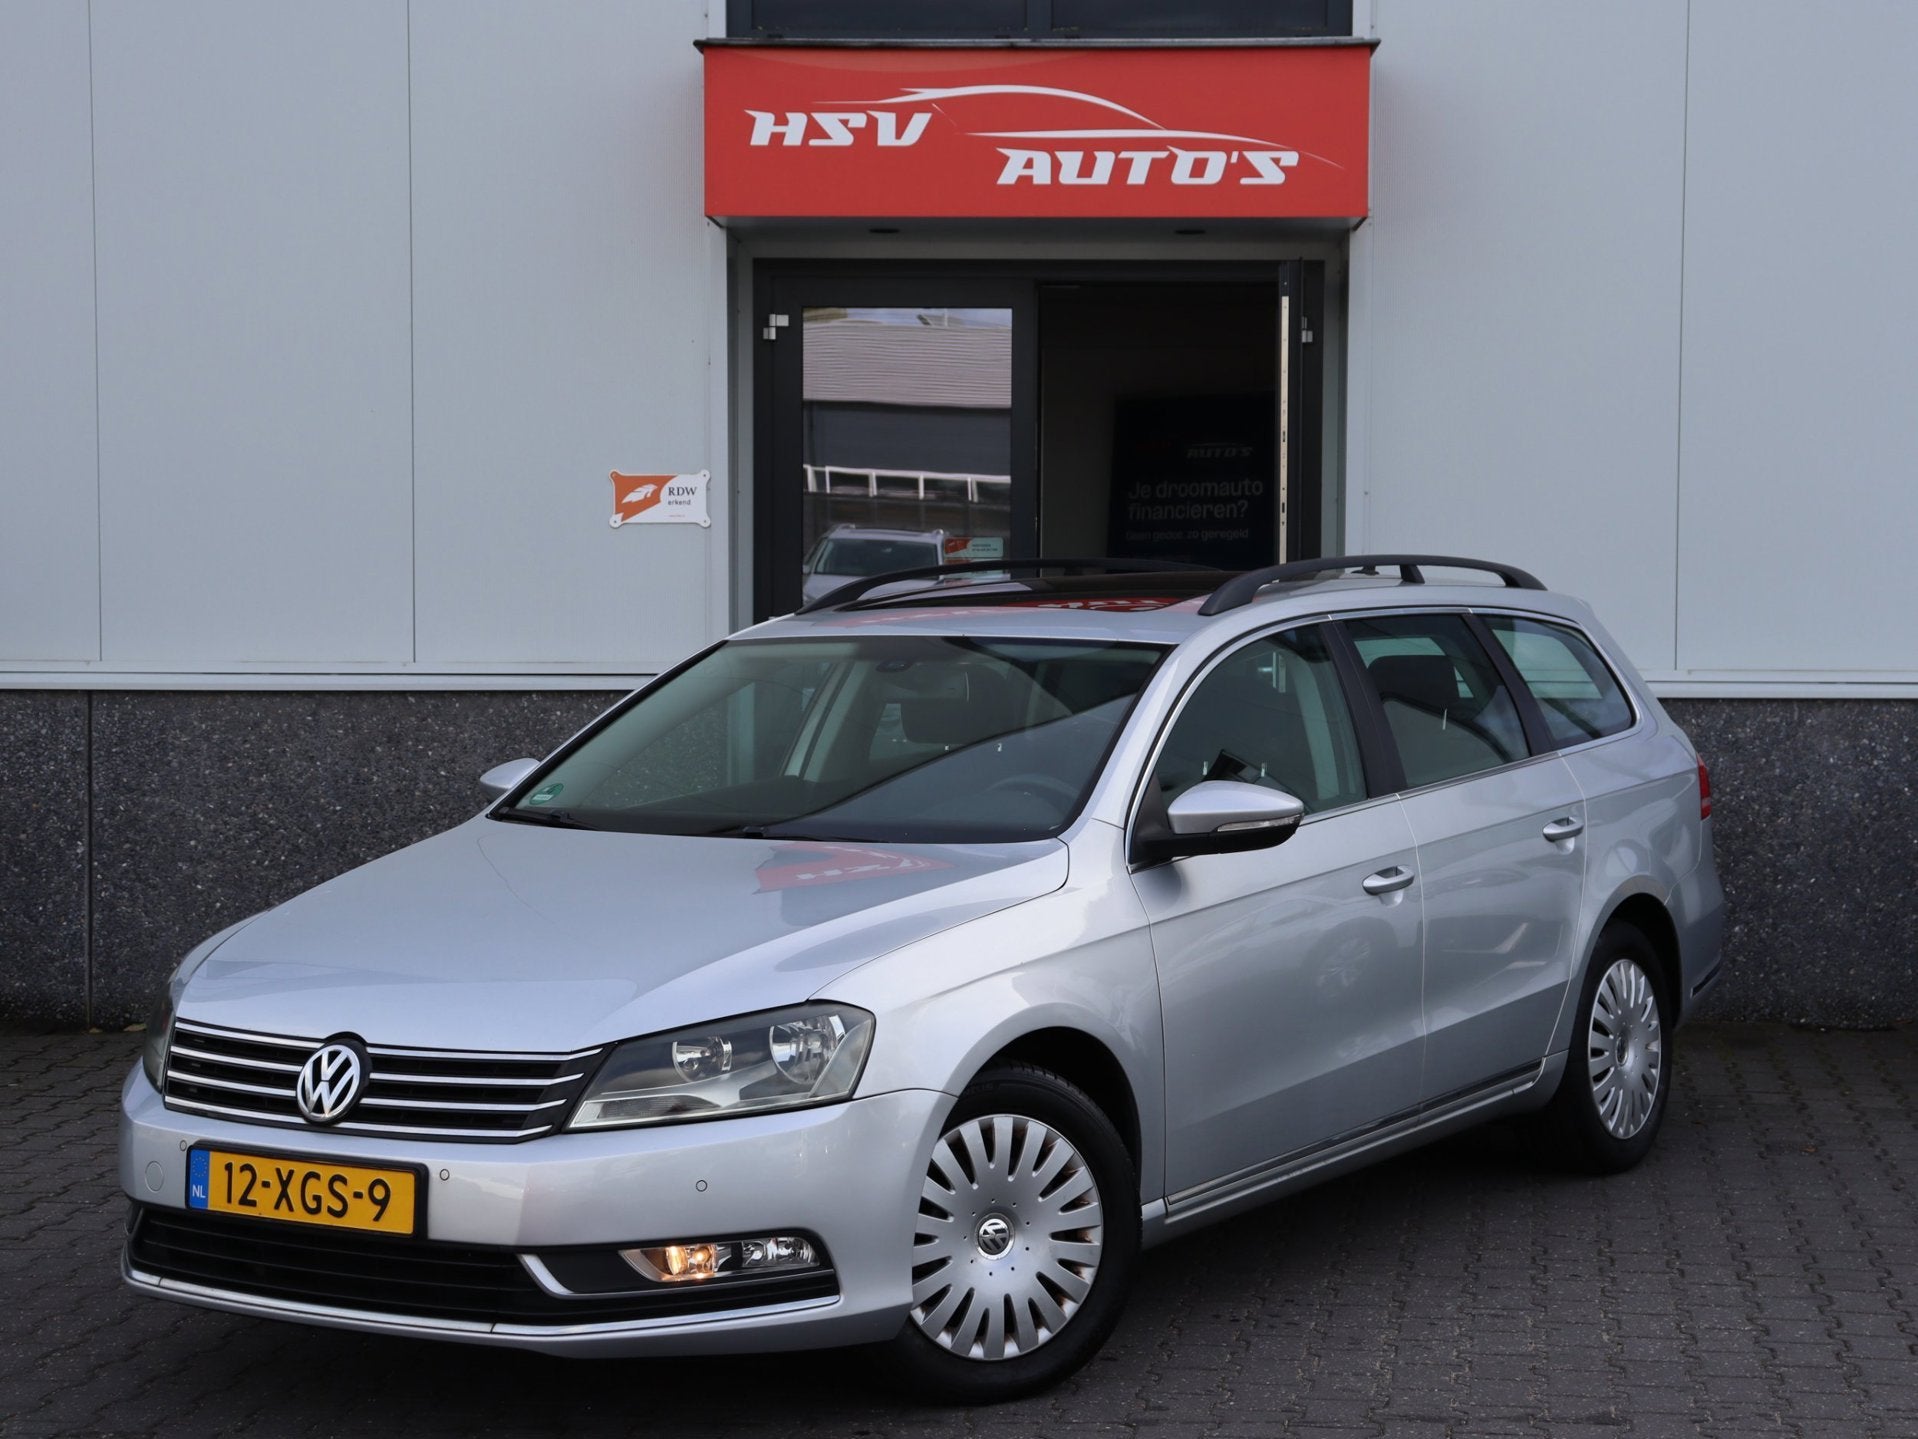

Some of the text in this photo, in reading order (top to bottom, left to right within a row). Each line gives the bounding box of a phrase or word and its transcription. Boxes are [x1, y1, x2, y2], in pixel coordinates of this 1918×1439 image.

[743, 109, 932, 146] HSV
[995, 145, 1299, 185] AUTO'S
[668, 486, 697, 496] RDW
[1128, 478, 1264, 499] Je droomauto
[1128, 499, 1249, 521] financieren?
[192, 1184, 206, 1199] NL
[223, 1161, 391, 1222] 12-XGS-9
